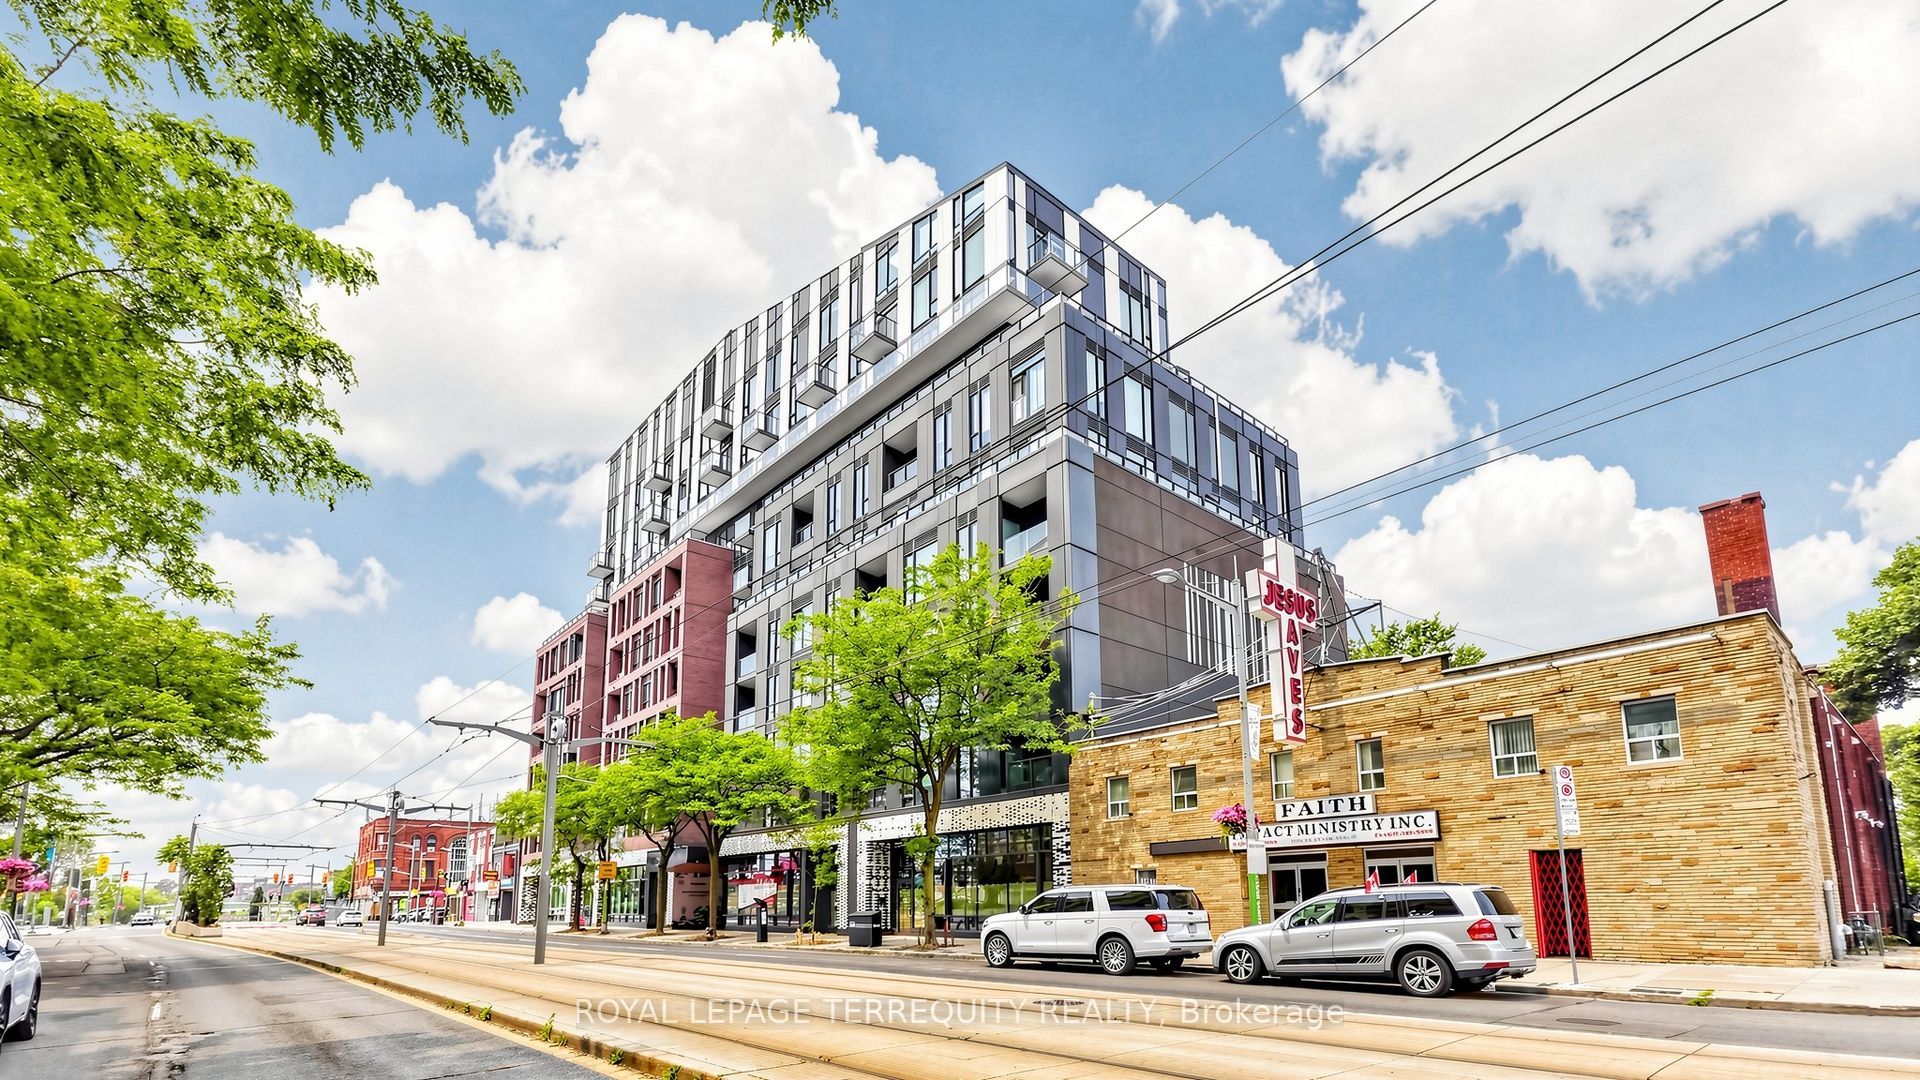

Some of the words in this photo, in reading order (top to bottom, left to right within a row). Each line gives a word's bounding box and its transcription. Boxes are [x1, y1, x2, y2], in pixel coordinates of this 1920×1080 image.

[1263, 580, 1316, 623] JESUS
[1281, 796, 1367, 817] FAITH
[1390, 814, 1432, 829] INC.
